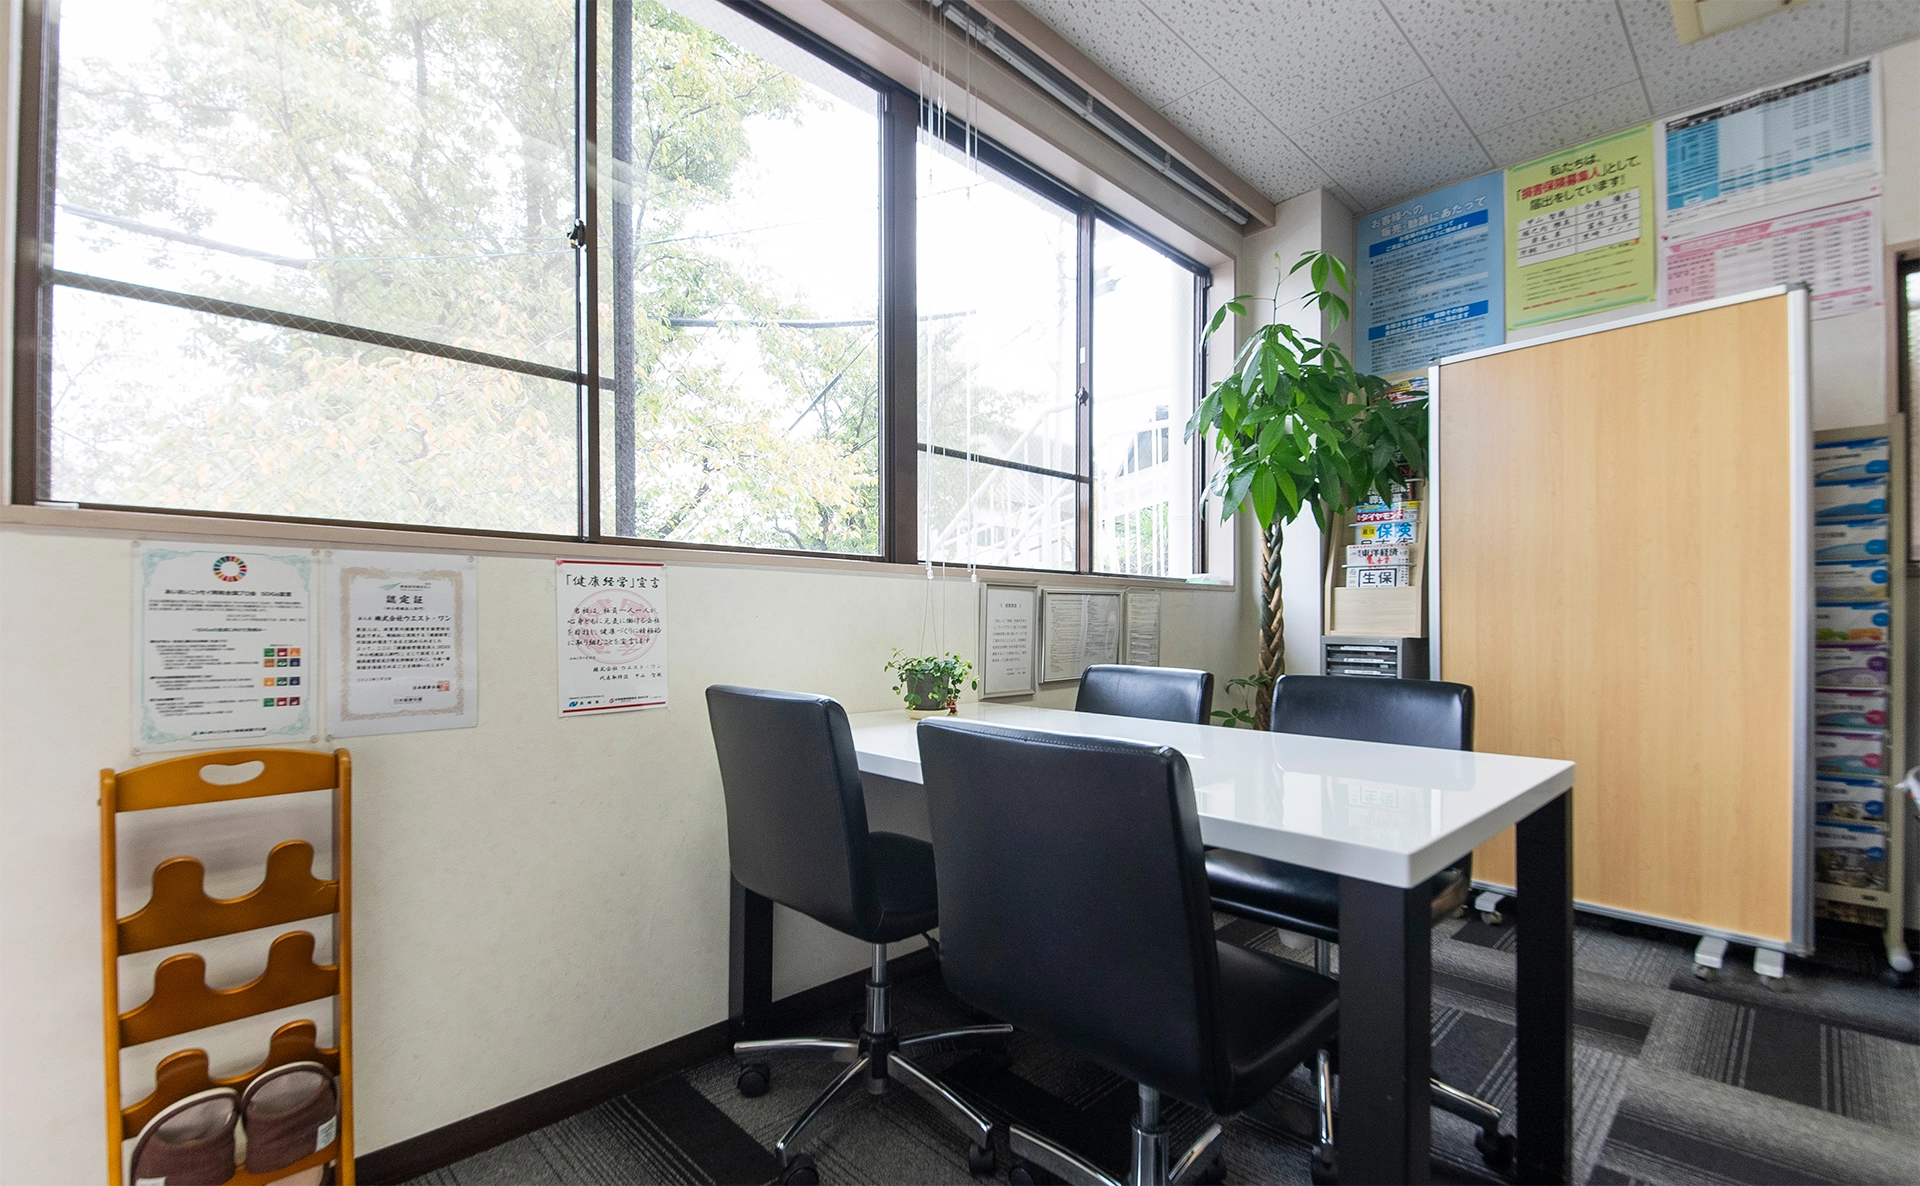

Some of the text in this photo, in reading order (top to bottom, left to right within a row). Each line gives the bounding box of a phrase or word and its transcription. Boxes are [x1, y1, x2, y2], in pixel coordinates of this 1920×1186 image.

[1370, 204, 1424, 229] お客様への
[1381, 195, 1487, 238] 販売・勧誘にあたって
[1360, 510, 1404, 522] ダイヤモンド
[1376, 522, 1413, 539] 保険
[1361, 547, 1399, 558] 東洋経済
[566, 574, 660, 589] 「健康経営」宣言
[1362, 571, 1393, 584] 生保
[385, 594, 424, 605] 認定証
